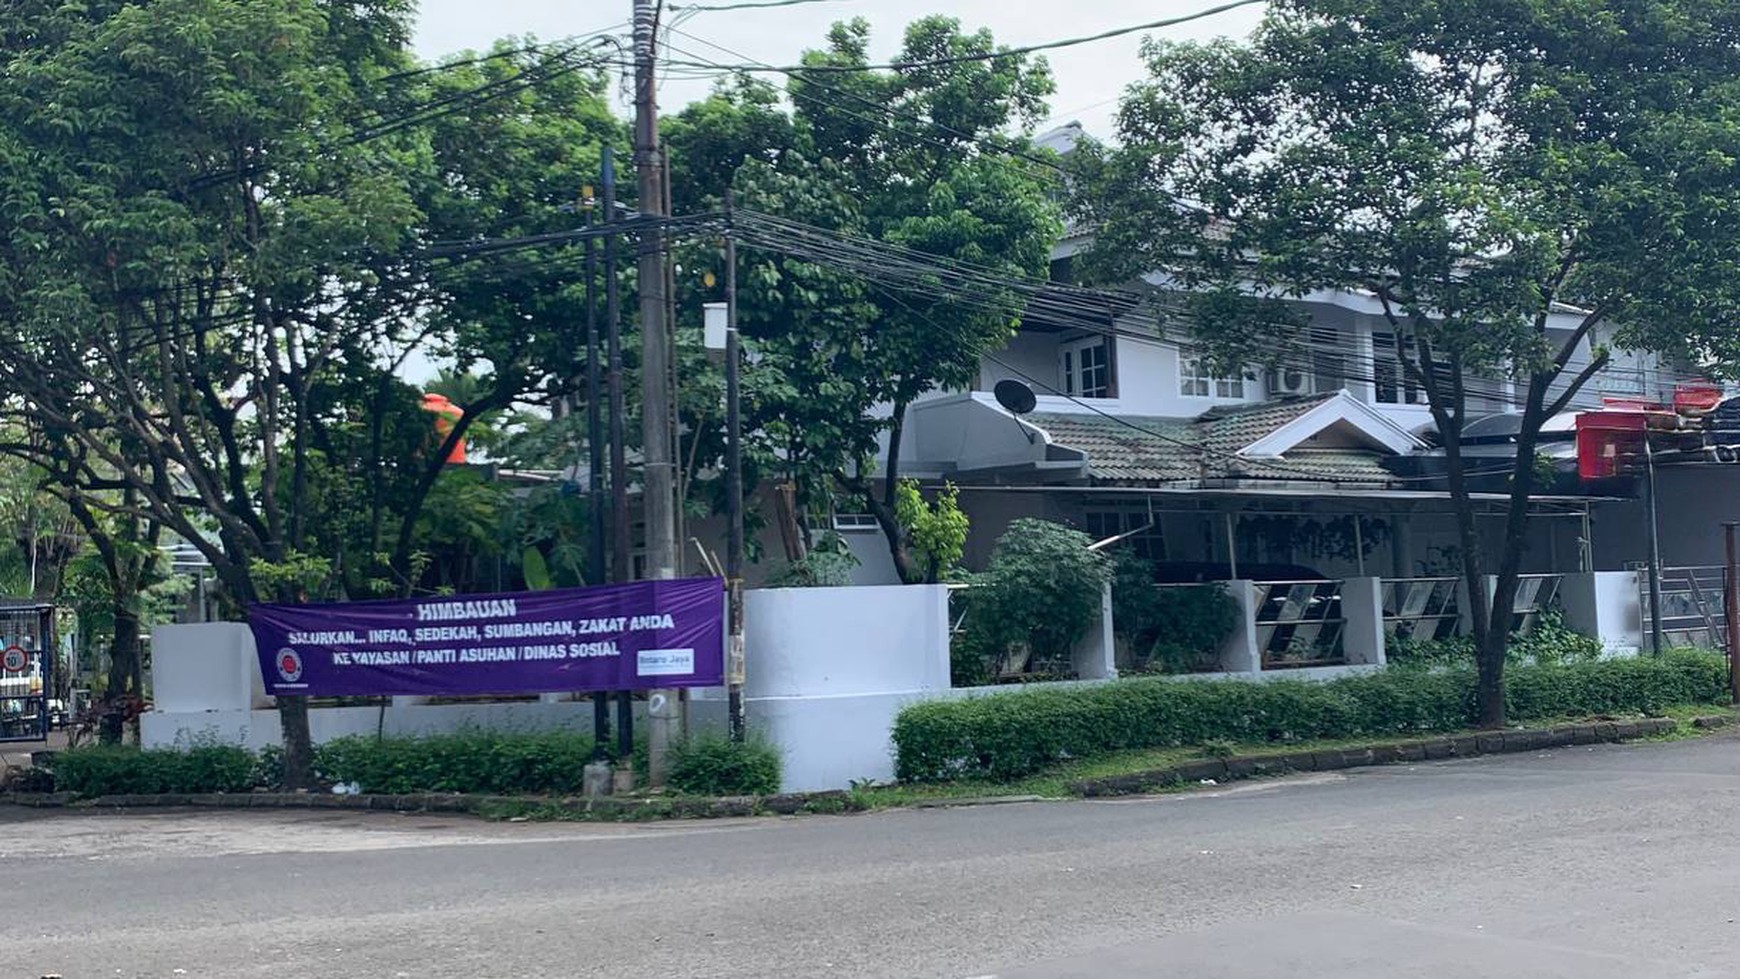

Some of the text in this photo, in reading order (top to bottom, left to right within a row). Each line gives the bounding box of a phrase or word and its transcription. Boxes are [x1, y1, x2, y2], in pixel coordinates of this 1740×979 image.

[417, 600, 517, 621] HIMBAUAN
[414, 625, 481, 643] SEDEKAH,
[484, 619, 576, 640] SUMBANGAN,
[579, 617, 627, 634] ZAKAT
[629, 613, 674, 631] ANDA
[333, 651, 352, 665] KE
[353, 651, 411, 665] YAYASAN
[459, 646, 515, 662] ASUHAN
[569, 641, 621, 658] SOSIAL
